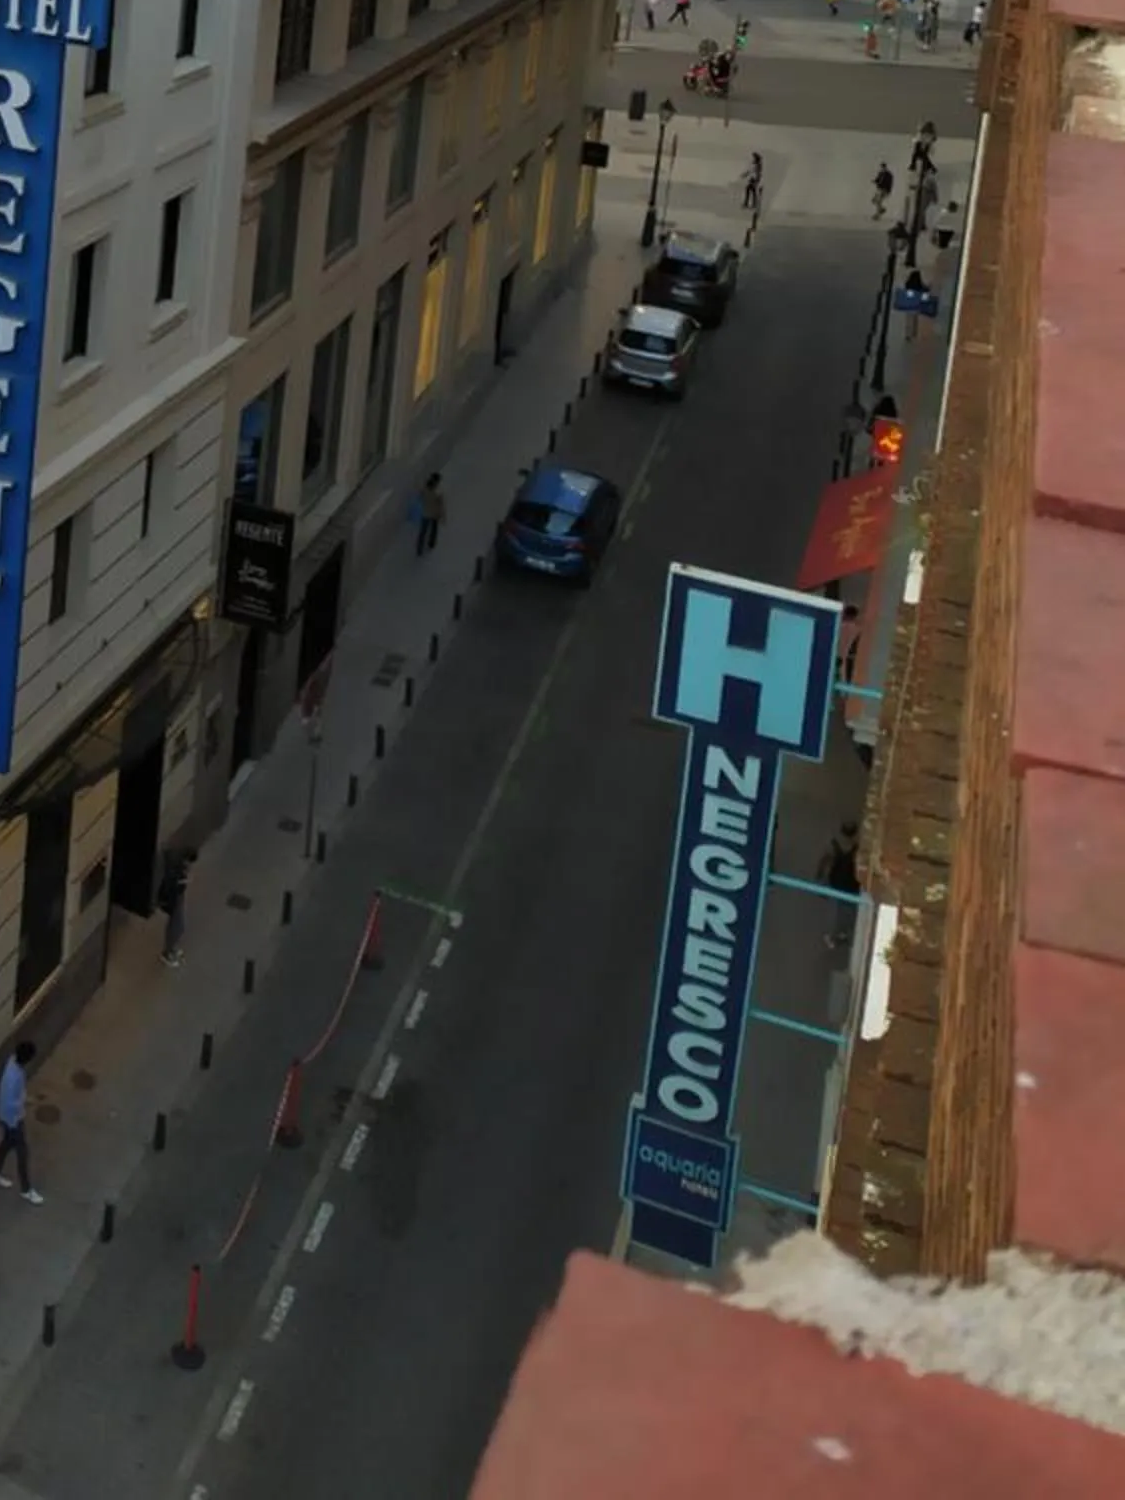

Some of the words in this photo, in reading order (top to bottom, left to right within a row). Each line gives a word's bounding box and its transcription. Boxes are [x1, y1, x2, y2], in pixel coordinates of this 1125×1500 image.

[676, 587, 816, 745] H
[657, 744, 762, 1123] NEGRESCO
[638, 1144, 721, 1188] aquaria
